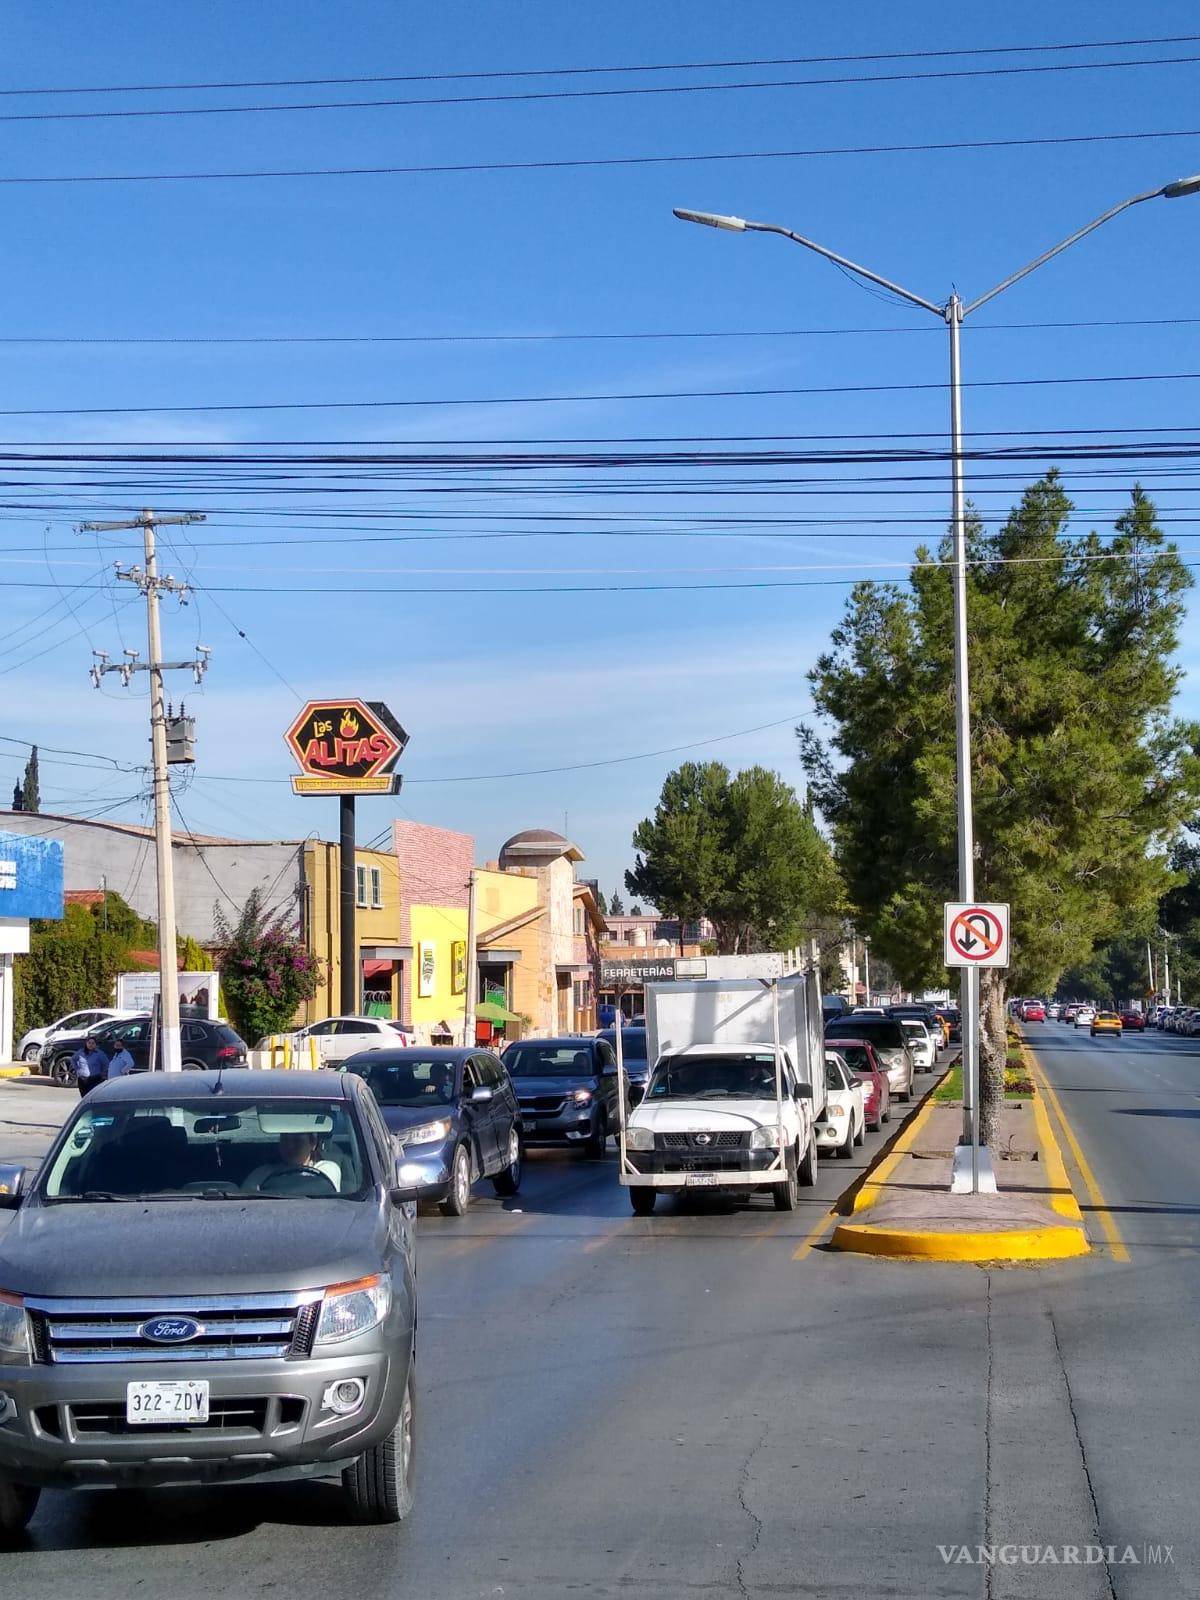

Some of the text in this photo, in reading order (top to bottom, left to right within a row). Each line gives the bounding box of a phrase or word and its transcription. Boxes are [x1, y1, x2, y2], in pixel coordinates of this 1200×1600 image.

[313, 720, 333, 738] Las
[303, 733, 389, 767] ALITAS
[604, 965, 674, 978] FERRETERÍAS
[153, 1321, 188, 1337] Ford
[132, 1392, 204, 1412] 322-ZDV
